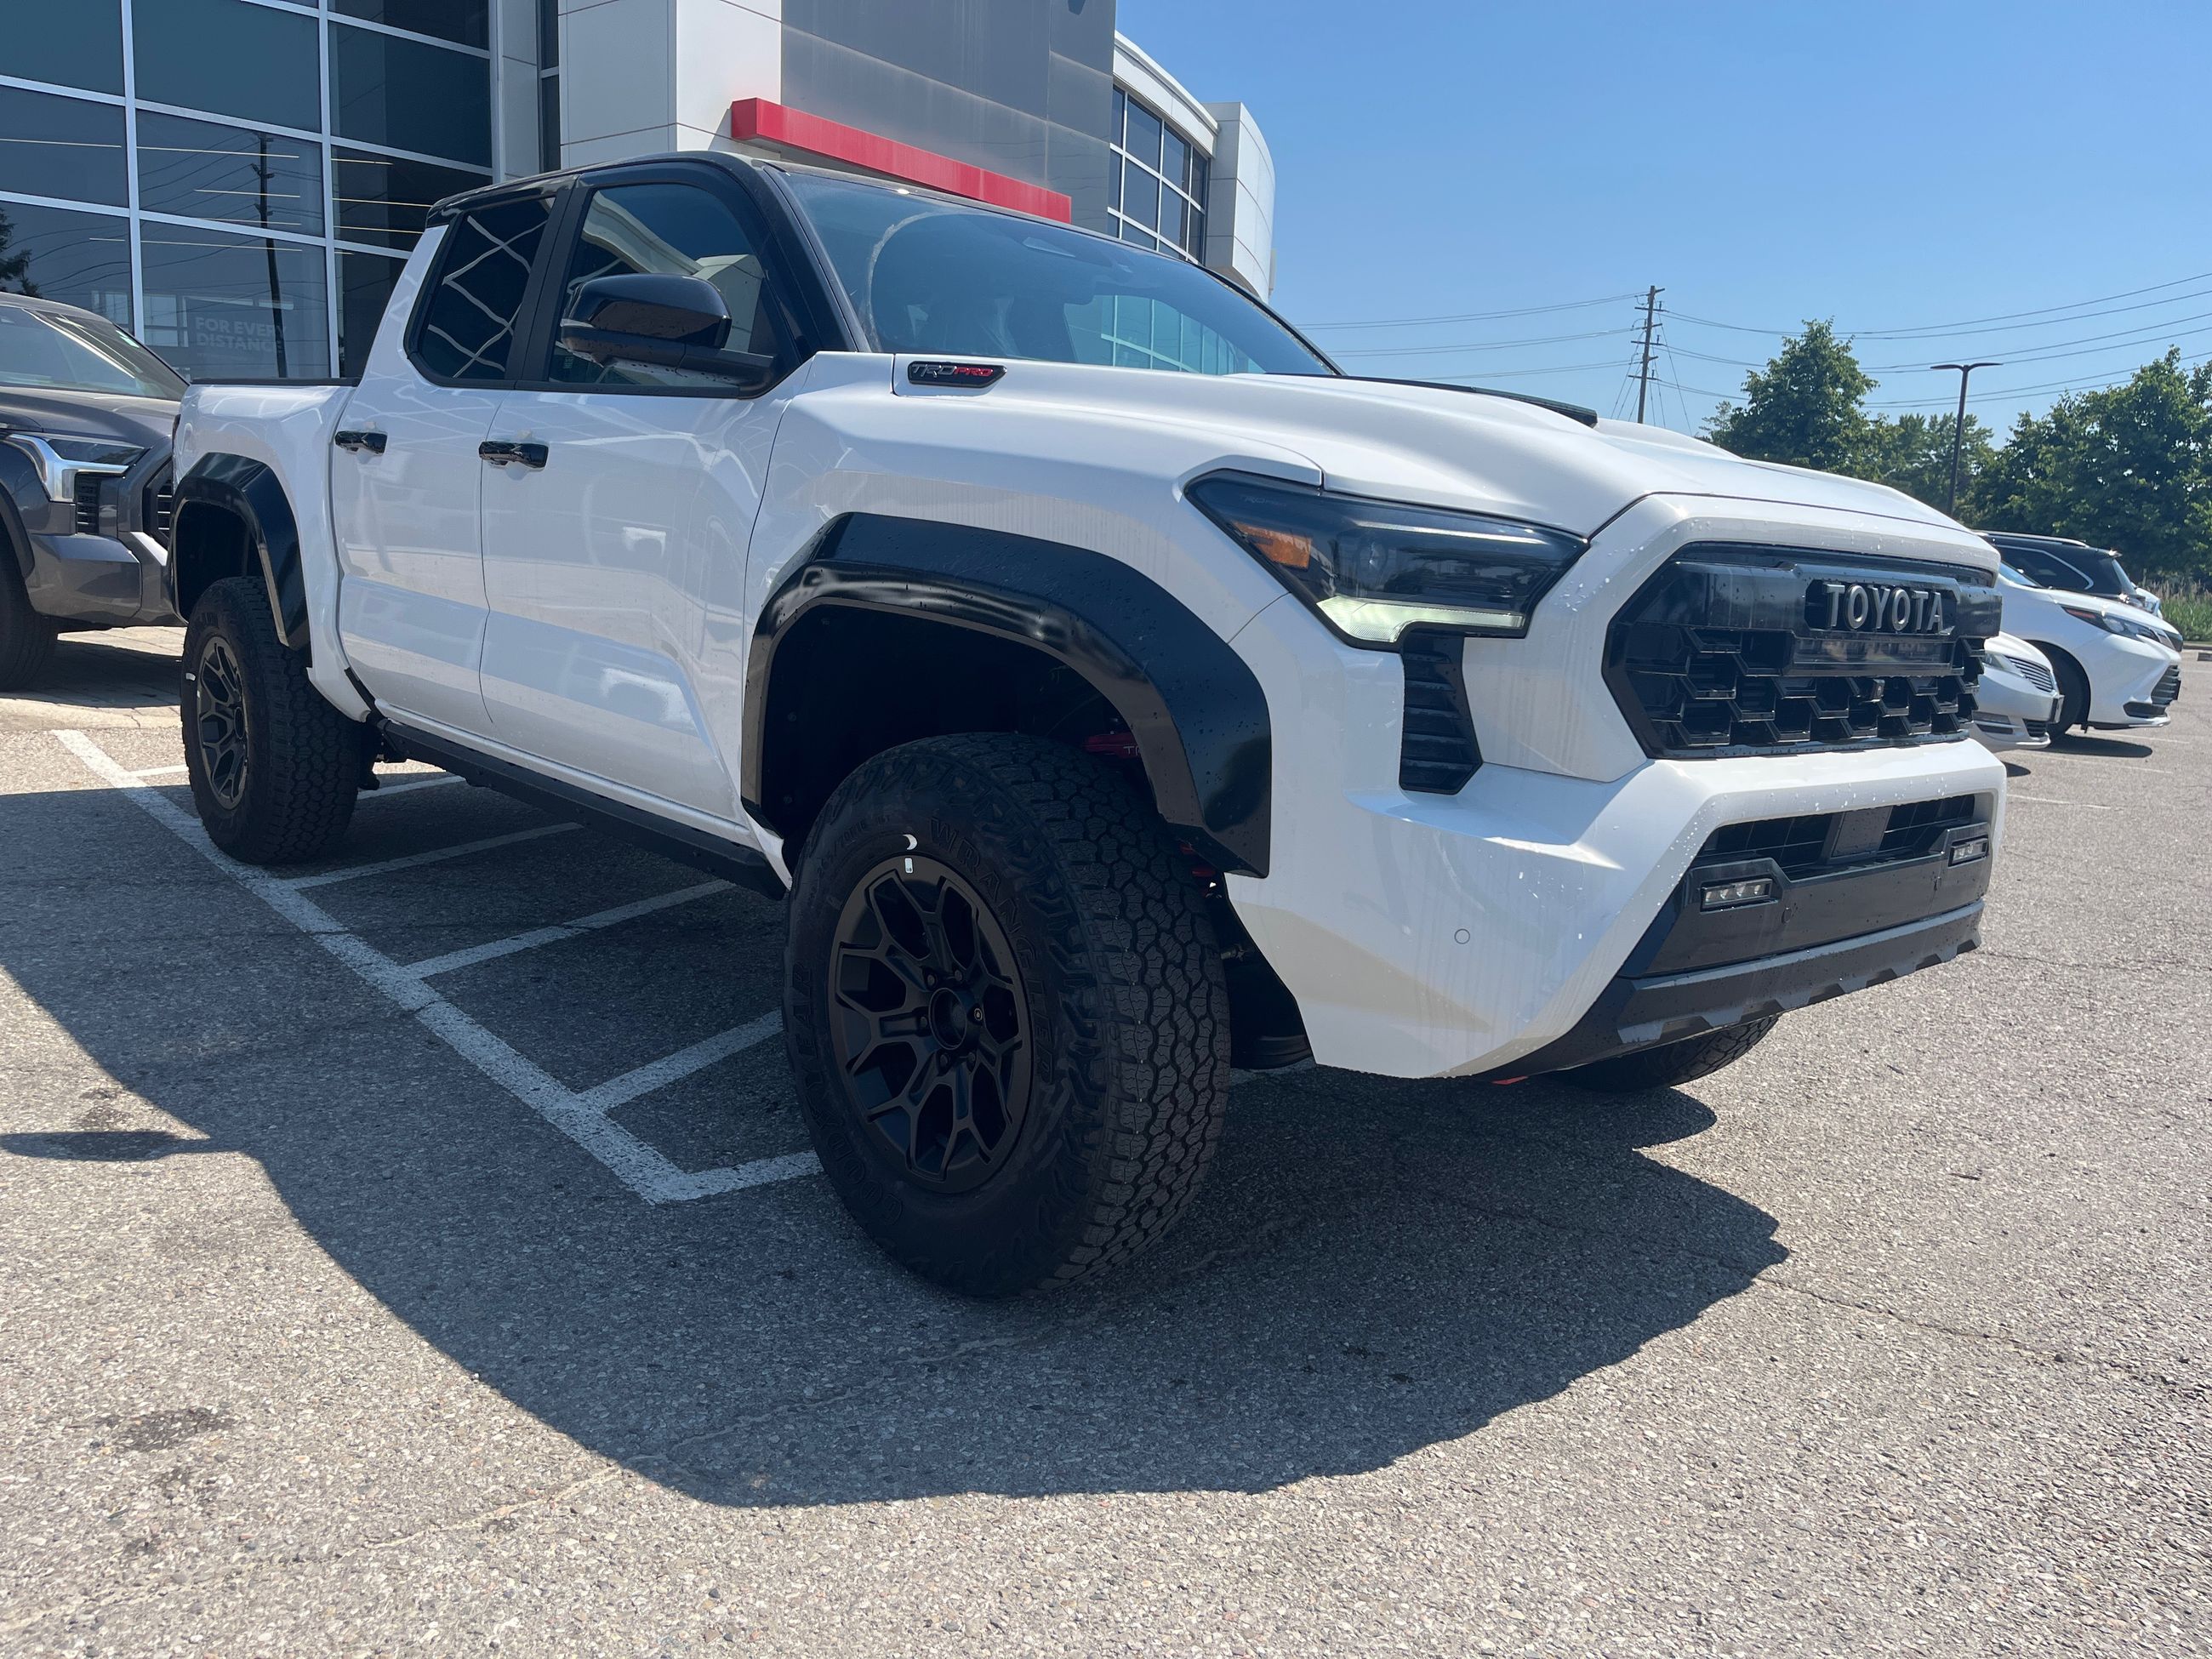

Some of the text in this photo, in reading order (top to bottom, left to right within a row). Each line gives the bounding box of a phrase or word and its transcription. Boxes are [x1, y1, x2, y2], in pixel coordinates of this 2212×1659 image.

[195, 316, 231, 333] FOR
[1825, 582, 1945, 632] TOYOTA
[929, 816, 1055, 1086] WRANGLER
